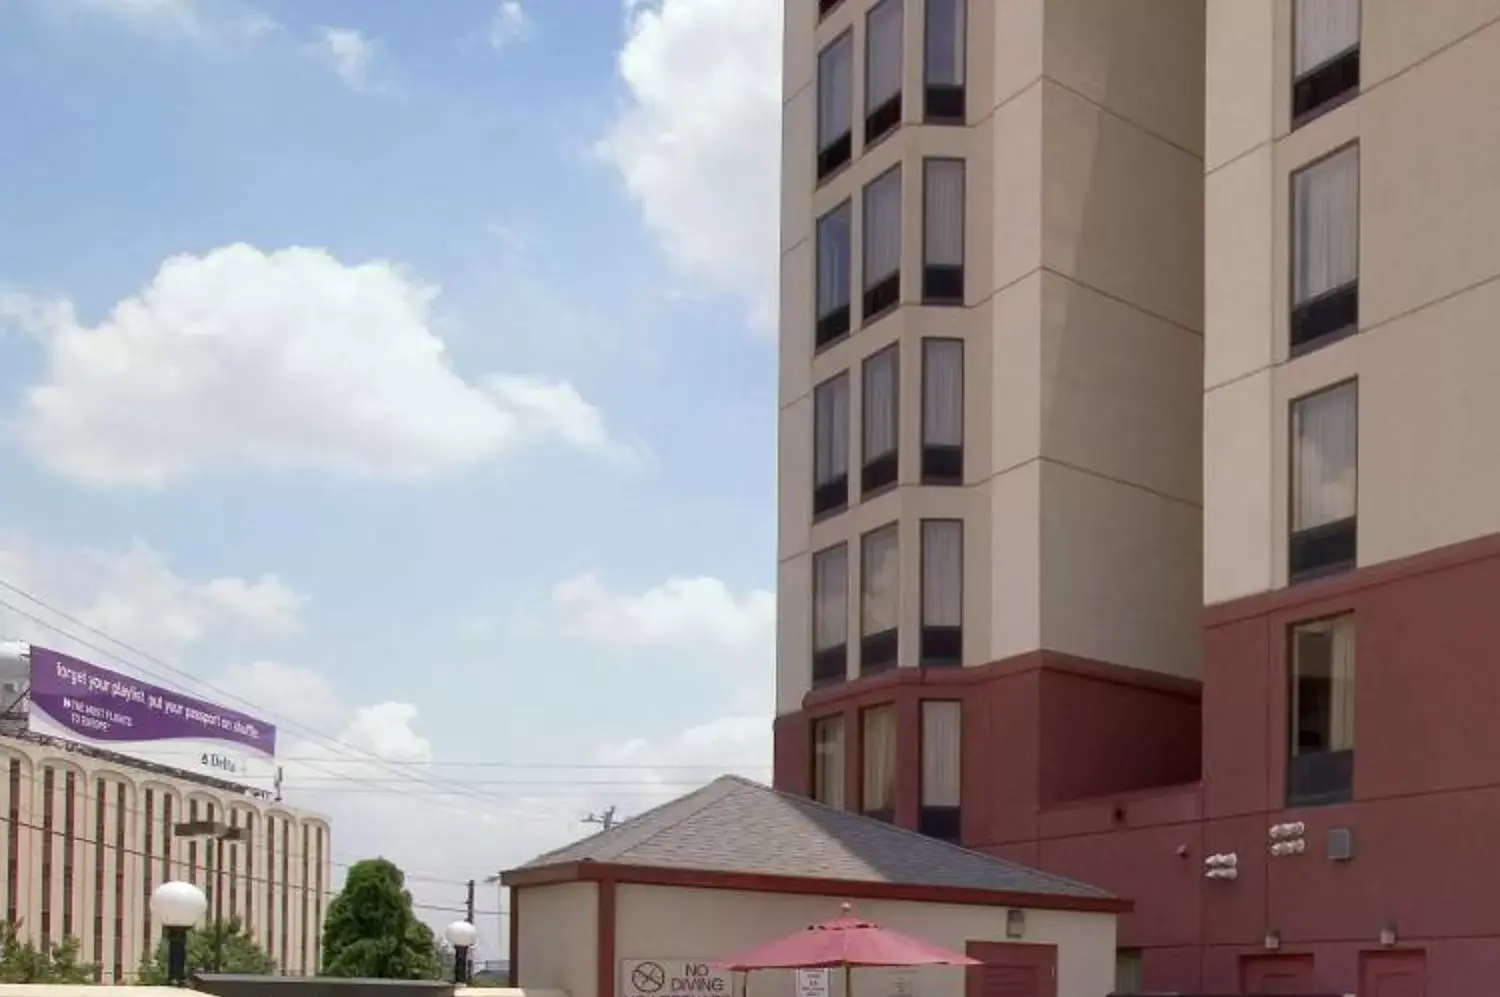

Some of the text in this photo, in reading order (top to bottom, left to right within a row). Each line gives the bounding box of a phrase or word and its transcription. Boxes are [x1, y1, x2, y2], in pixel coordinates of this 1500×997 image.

[88, 675, 111, 692] your
[685, 962, 709, 977] NO
[670, 978, 726, 992] DIVING
